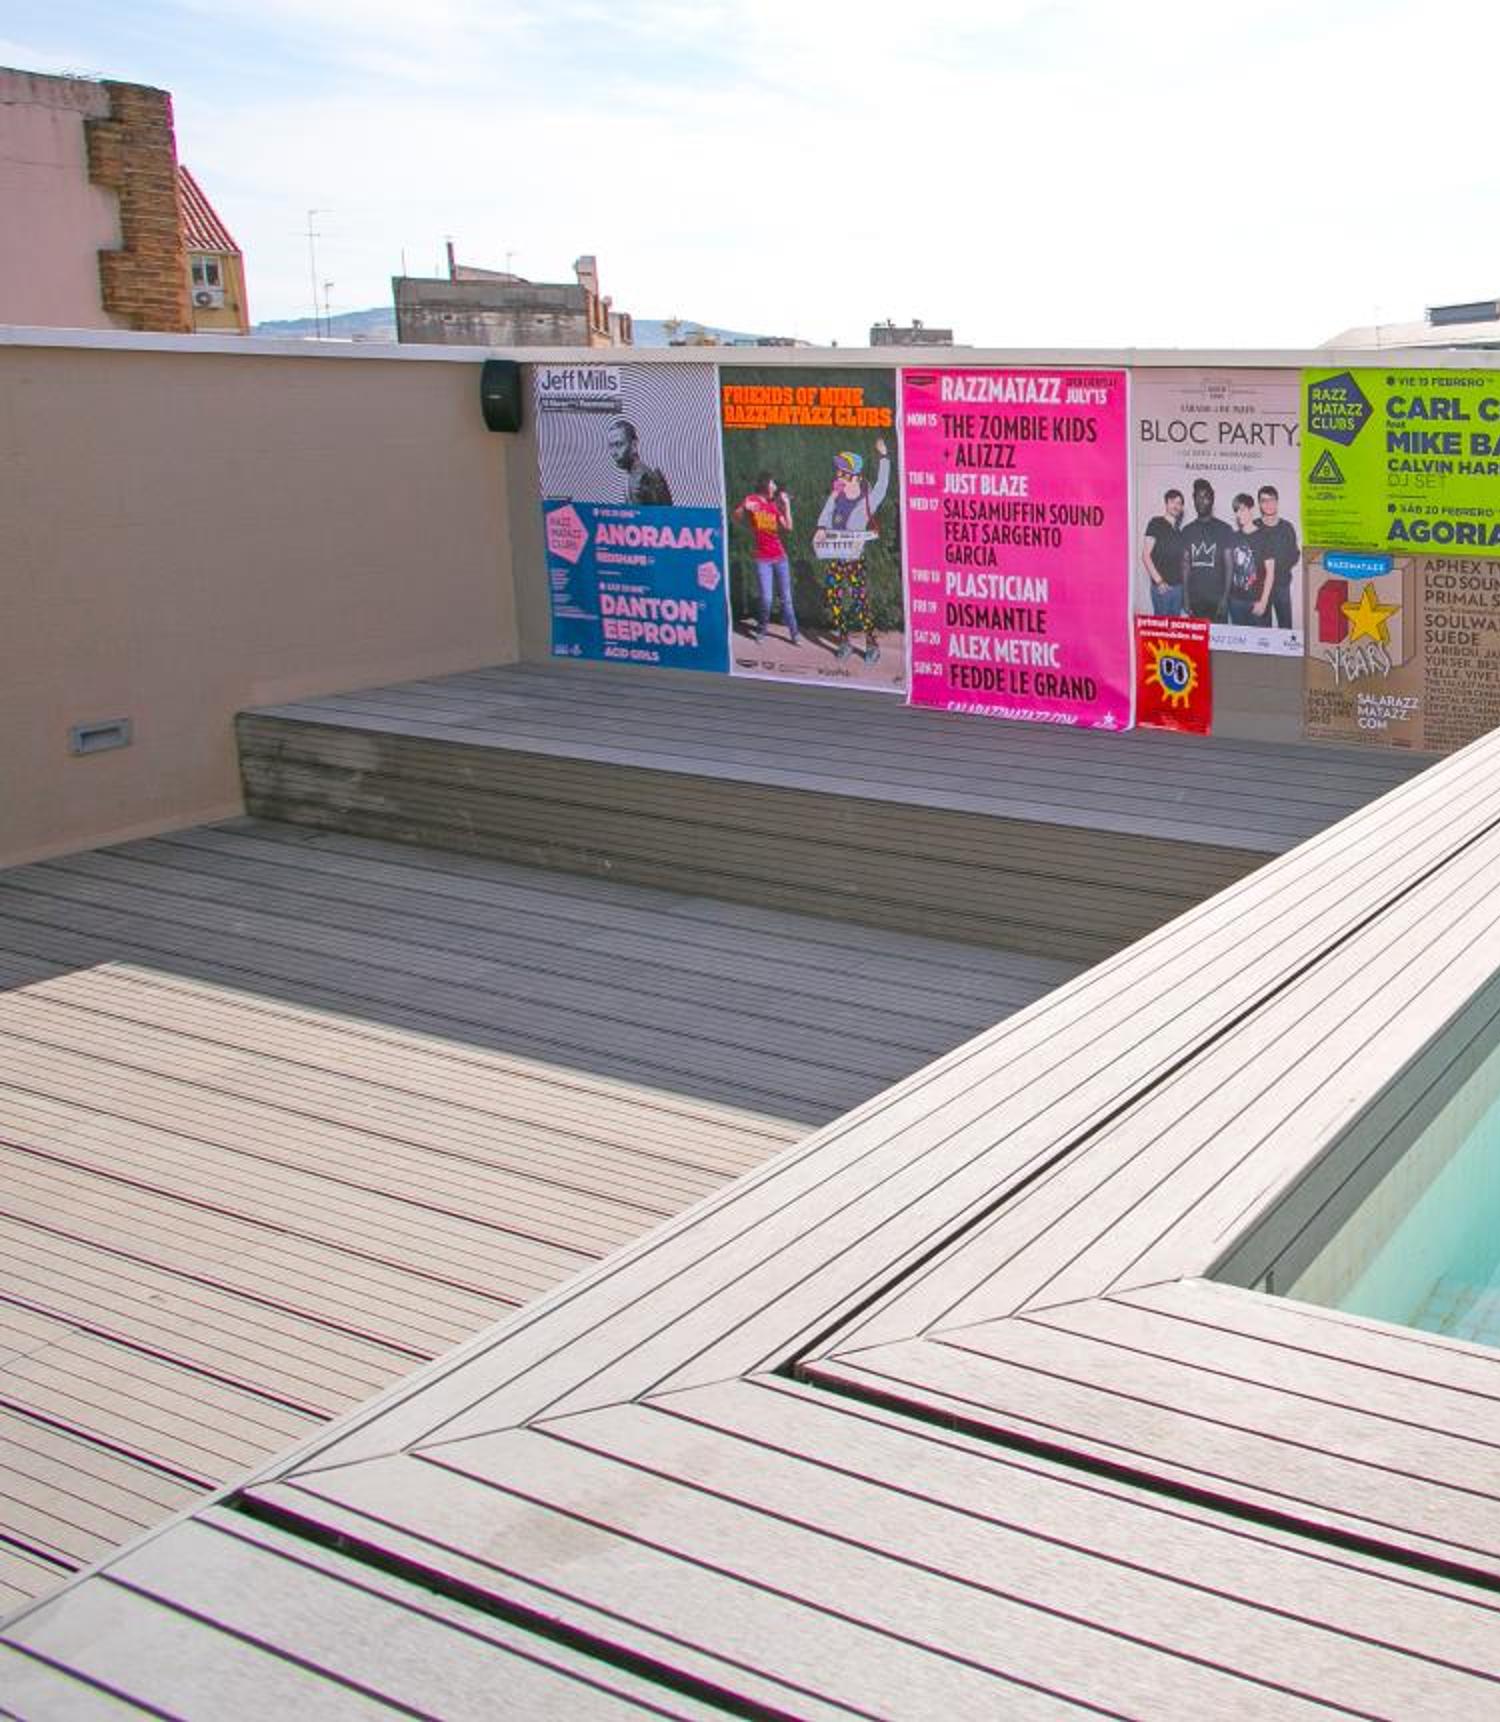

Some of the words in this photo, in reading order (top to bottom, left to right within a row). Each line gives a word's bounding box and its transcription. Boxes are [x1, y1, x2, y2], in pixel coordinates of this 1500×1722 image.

[542, 370, 575, 390] Jeff
[578, 370, 617, 391] Mills
[941, 377, 1062, 404] RAZZMATAZZ
[1432, 378, 1485, 388] FEBRERO
[723, 385, 794, 404] FRIENDS
[796, 386, 818, 405] OF
[819, 387, 864, 406] MINE
[1311, 388, 1348, 402] RAZZ
[724, 405, 833, 425] RAZZMATAZZ
[834, 407, 892, 428] CLUBS
[1311, 402, 1363, 416] MATAZZ
[1386, 395, 1470, 420] CARL
[942, 414, 974, 439] THE
[980, 416, 1048, 442] ZOMBIE
[1053, 417, 1098, 443] KIDS
[1140, 419, 1208, 444] BLOC
[1312, 417, 1355, 430] CLUBS
[1386, 432, 1462, 454] MIKE
[956, 444, 1016, 469] ALIZZZ
[1388, 459, 1450, 474] CALVIN
[944, 473, 979, 495] JUST
[980, 474, 1028, 496] BLAZE
[1388, 474, 1408, 487] DJ
[1416, 475, 1446, 489] SET
[943, 500, 1046, 524] SALSAMUFFIN
[1050, 505, 1104, 527] SOUND
[1441, 506, 1495, 518] FEBRERO
[594, 523, 715, 550] ANORAAK
[944, 522, 978, 542] FEAT
[982, 524, 1062, 548] SARGENTO
[945, 544, 998, 566] GARCIA
[1424, 560, 1482, 574] APHEX
[946, 572, 1048, 603] PLASTICIAN
[1424, 575, 1456, 588] LCD
[599, 594, 698, 622] DANTON
[1424, 590, 1488, 607] PRIMAL
[946, 602, 1047, 634] DISMANTLE
[603, 617, 698, 648] EEPROM
[1424, 630, 1480, 646] SUEDE
[948, 634, 992, 662] ALEX
[993, 636, 1061, 668] METRIC
[950, 664, 1006, 692] FEDDE
[1010, 670, 1029, 695] LE
[1034, 672, 1098, 701] GRAND
[1357, 692, 1419, 709] SALARAZZ
[1358, 718, 1388, 730] COM
